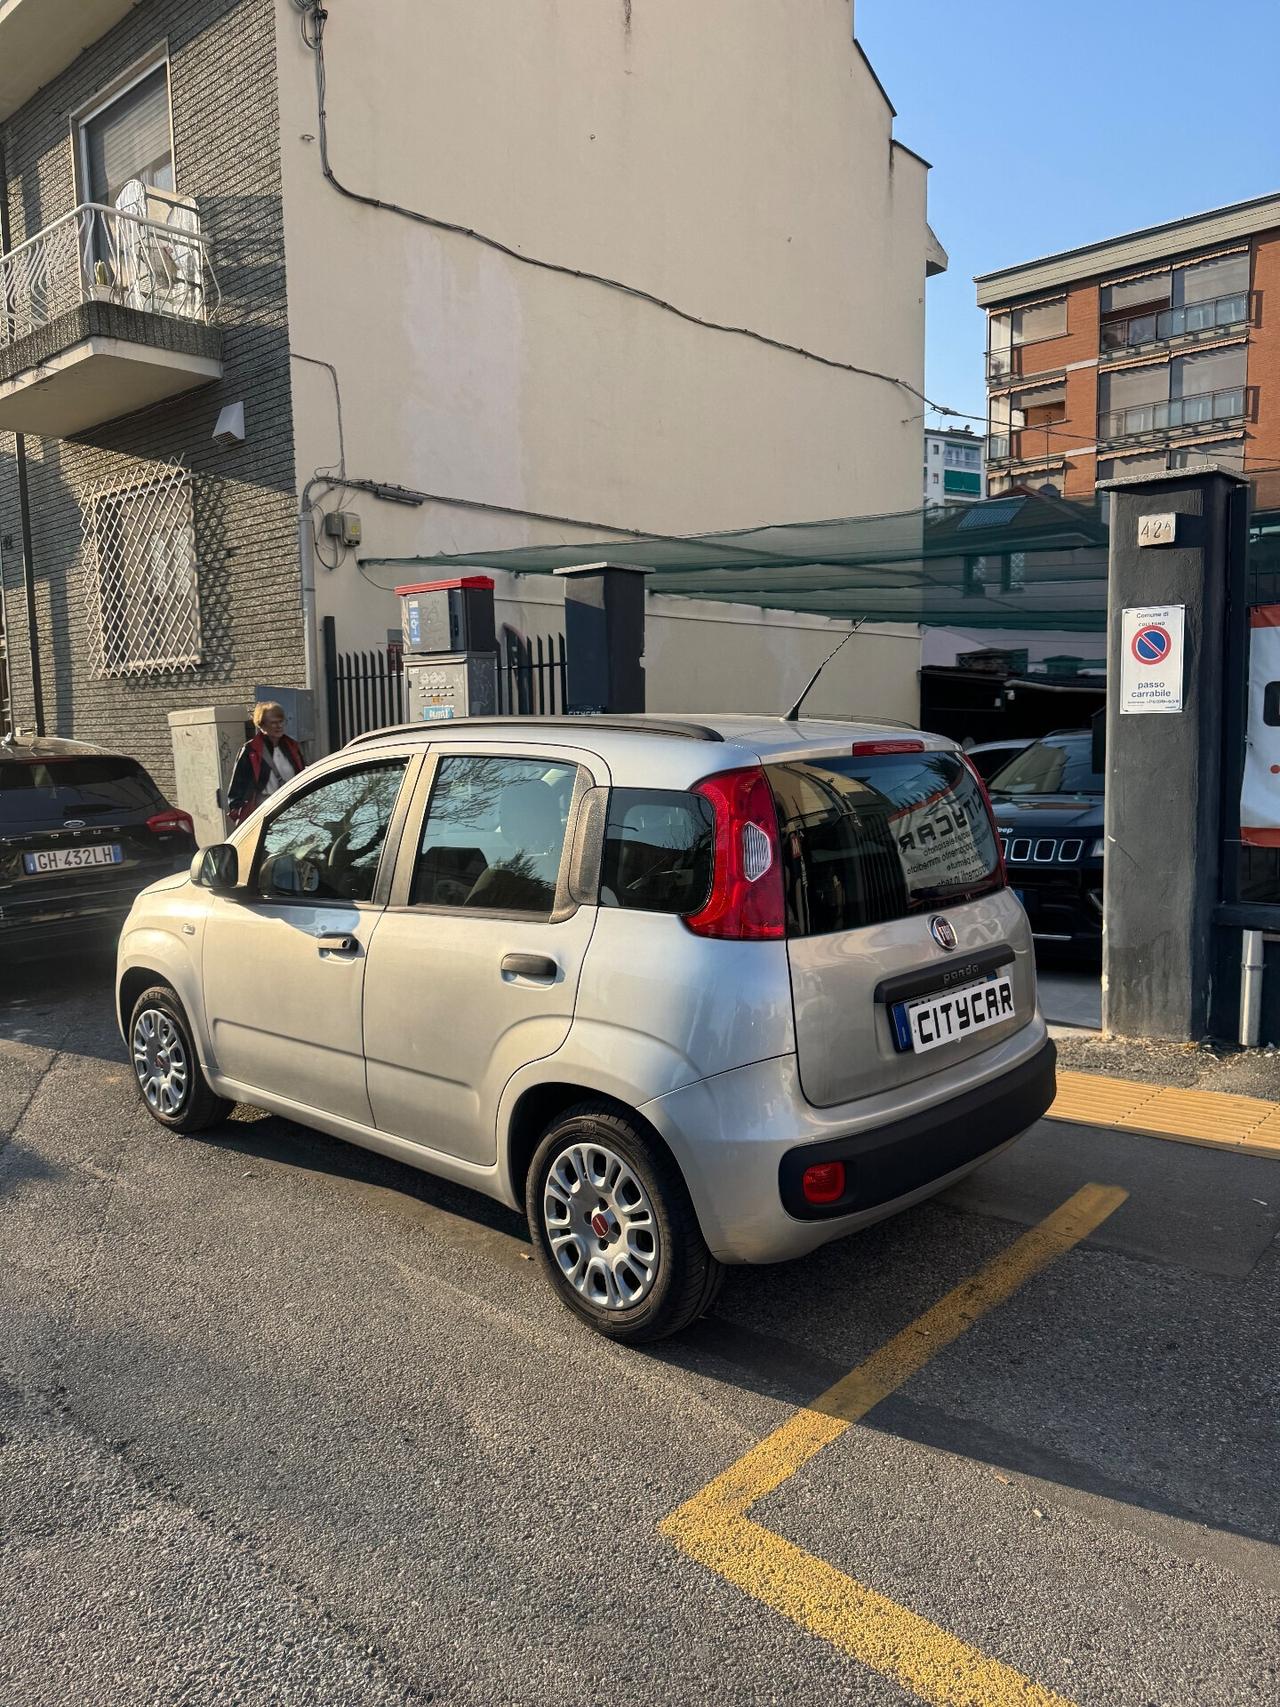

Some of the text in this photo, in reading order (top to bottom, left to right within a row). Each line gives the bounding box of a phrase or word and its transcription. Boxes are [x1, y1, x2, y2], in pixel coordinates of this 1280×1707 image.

[1131, 689, 1171, 698] carrabile
[1137, 682, 1165, 690] passo
[996, 826, 1014, 834] eep
[37, 847, 113, 870] GH 432LH
[943, 964, 979, 985] panda
[917, 983, 1013, 1045] CITYCAR
